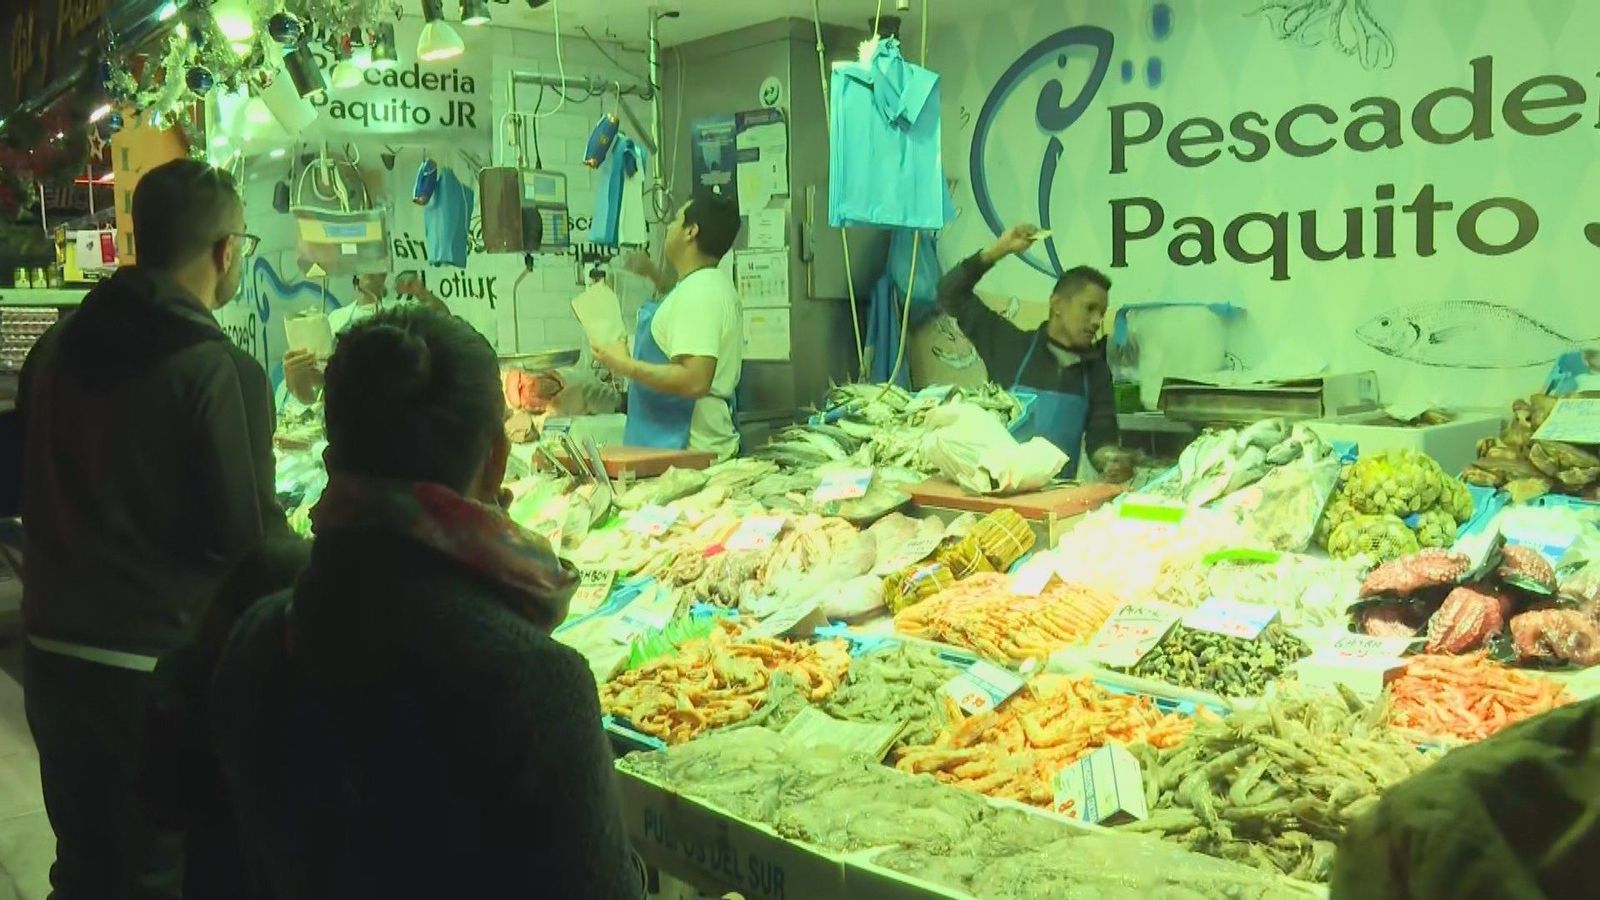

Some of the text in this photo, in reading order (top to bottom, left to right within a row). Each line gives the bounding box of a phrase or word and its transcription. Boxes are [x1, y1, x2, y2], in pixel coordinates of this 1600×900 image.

[313, 53, 475, 94] caderia
[439, 99, 477, 129] JR
[1107, 55, 1600, 174] Pescade
[1108, 183, 1539, 281] Paquito
[579, 569, 608, 583] MBON
[644, 807, 706, 864] PULOS
[748, 853, 786, 900] SUR
